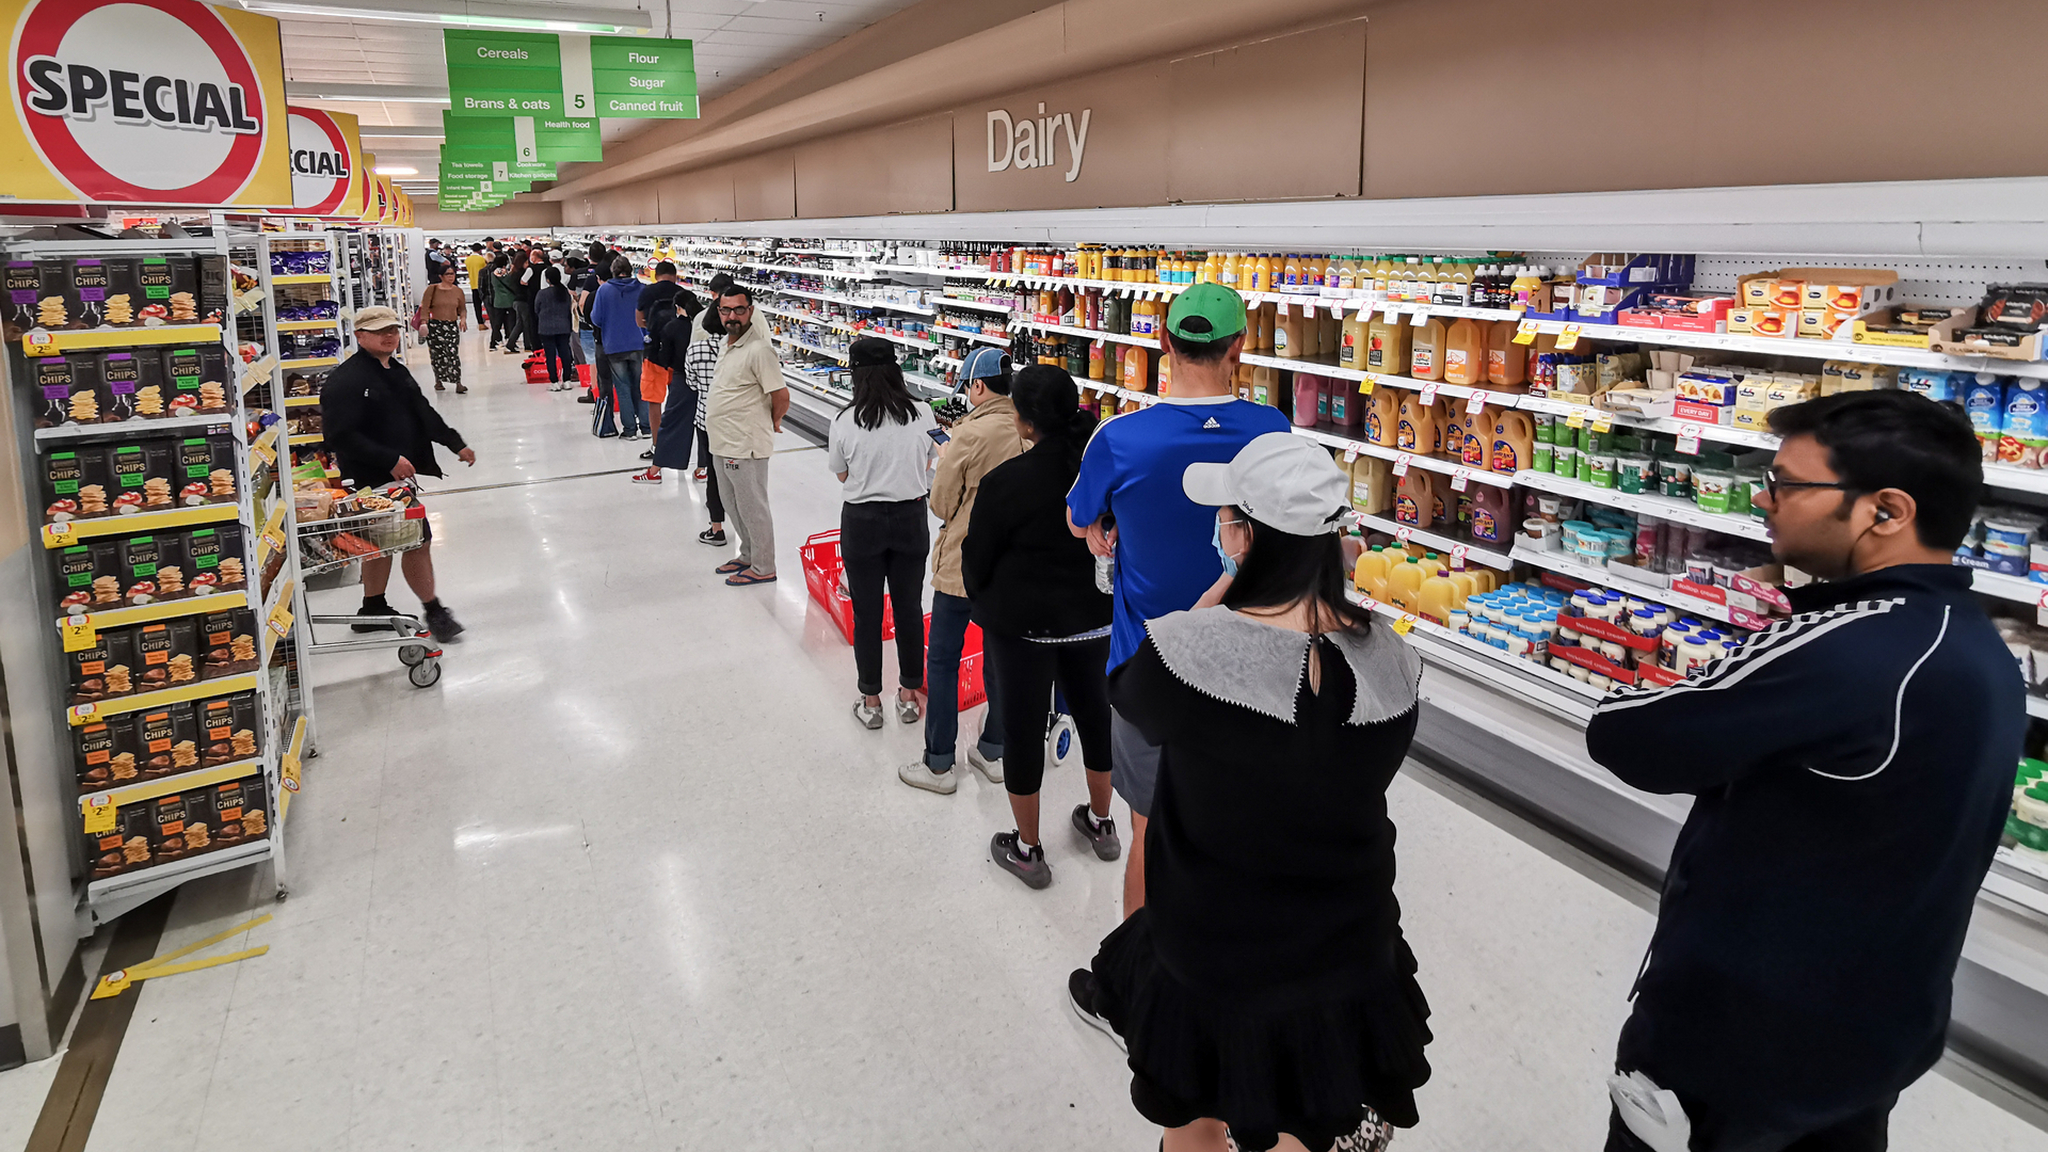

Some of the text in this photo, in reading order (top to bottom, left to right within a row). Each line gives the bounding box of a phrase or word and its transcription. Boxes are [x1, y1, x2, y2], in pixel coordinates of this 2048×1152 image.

[477, 47, 528, 60] Cereals
[629, 53, 659, 64] Flour
[629, 77, 665, 90] Sugar
[29, 59, 256, 130] SPECIAL
[464, 97, 551, 110] Brans & oats
[574, 94, 585, 109] 5
[609, 100, 684, 112] Canned fruit
[544, 120, 590, 129] Health food
[987, 102, 1091, 182] Dairy
[523, 147, 531, 157] 6
[290, 149, 347, 176] CIAL
[7, 278, 40, 289] CHIPS
[75, 276, 107, 286] CHIPS
[141, 275, 171, 285] CHIPS
[107, 370, 137, 380] CHIPS
[172, 366, 201, 375] CHIPS
[39, 374, 71, 384] CHIPS
[1680, 407, 1710, 418] EVERY DAY
[182, 454, 211, 464] CHIPS
[115, 462, 146, 473] CHIPS
[49, 469, 81, 480] CHIPS
[190, 544, 220, 556] CHIPS
[128, 553, 158, 565] CHIPS
[1961, 556, 1990, 569] Cream
[62, 561, 94, 574] CHIPS
[1700, 590, 1721, 600] cream
[205, 621, 233, 633] CHIPS
[1575, 621, 1628, 642] thickened cream
[141, 640, 171, 652] CHIPS
[77, 650, 108, 662] CHIPS
[1565, 651, 1613, 673] thickened cream
[205, 716, 233, 728] CHIPS
[144, 728, 173, 741] CHIPS
[82, 739, 112, 752] CHIPS
[217, 797, 244, 809] CHIPS
[157, 810, 186, 824] CHIPS
